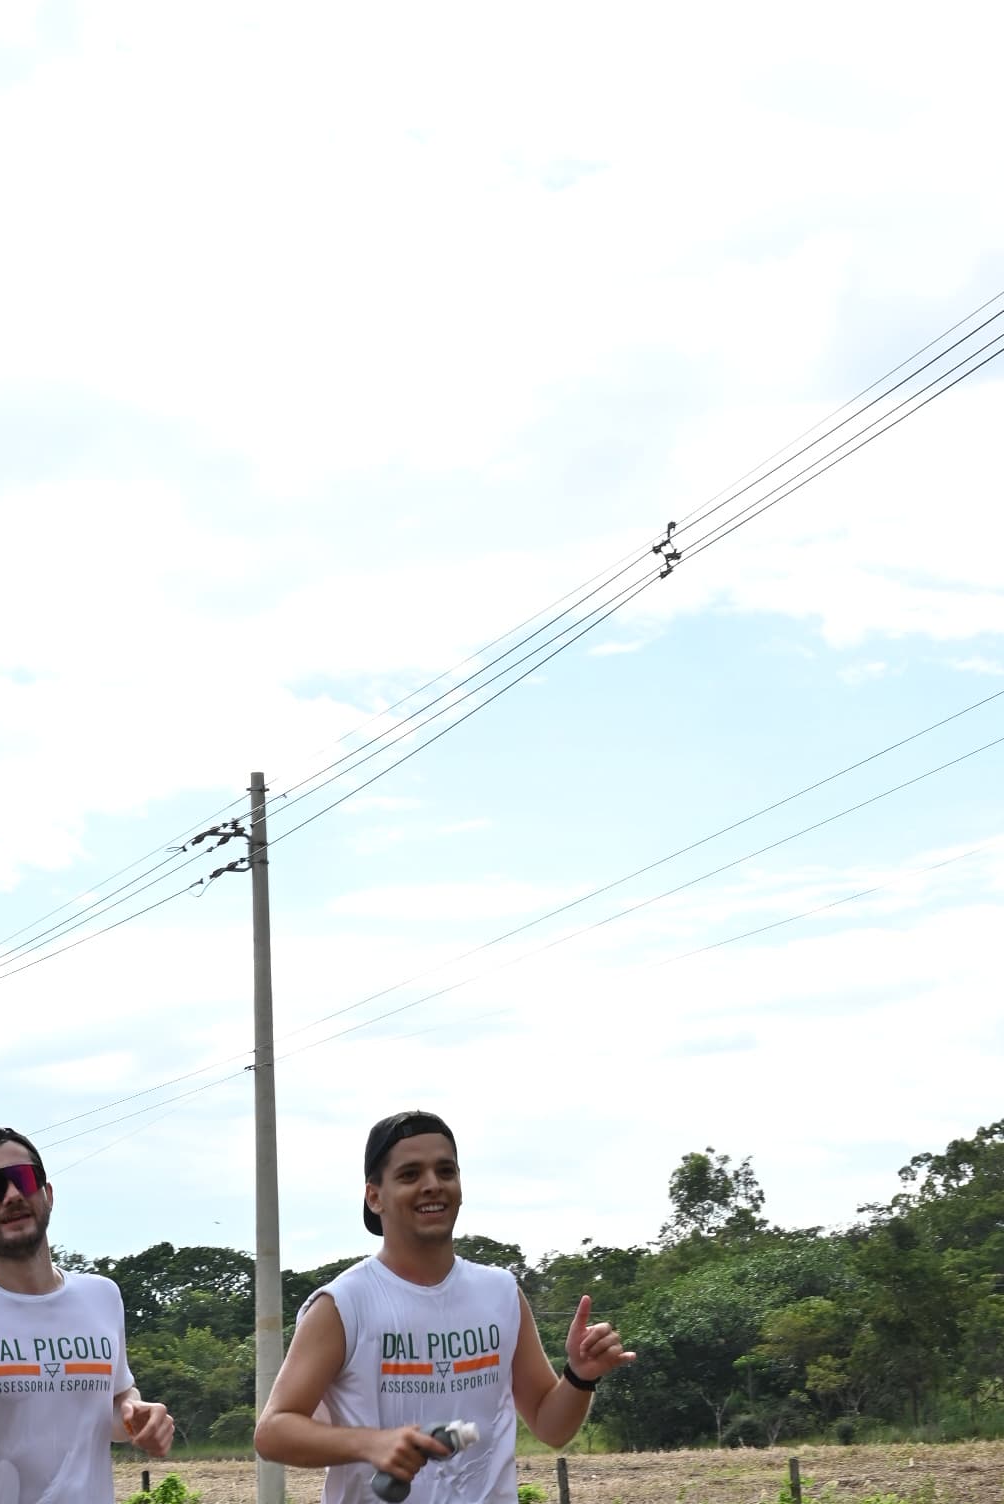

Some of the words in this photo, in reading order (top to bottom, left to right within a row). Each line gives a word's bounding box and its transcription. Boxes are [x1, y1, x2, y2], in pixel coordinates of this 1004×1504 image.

[34, 1336, 112, 1361] PICOLO
[382, 1333, 420, 1360] DAL
[427, 1323, 500, 1360] PICOLO
[380, 1380, 446, 1395] ASSESSORIA
